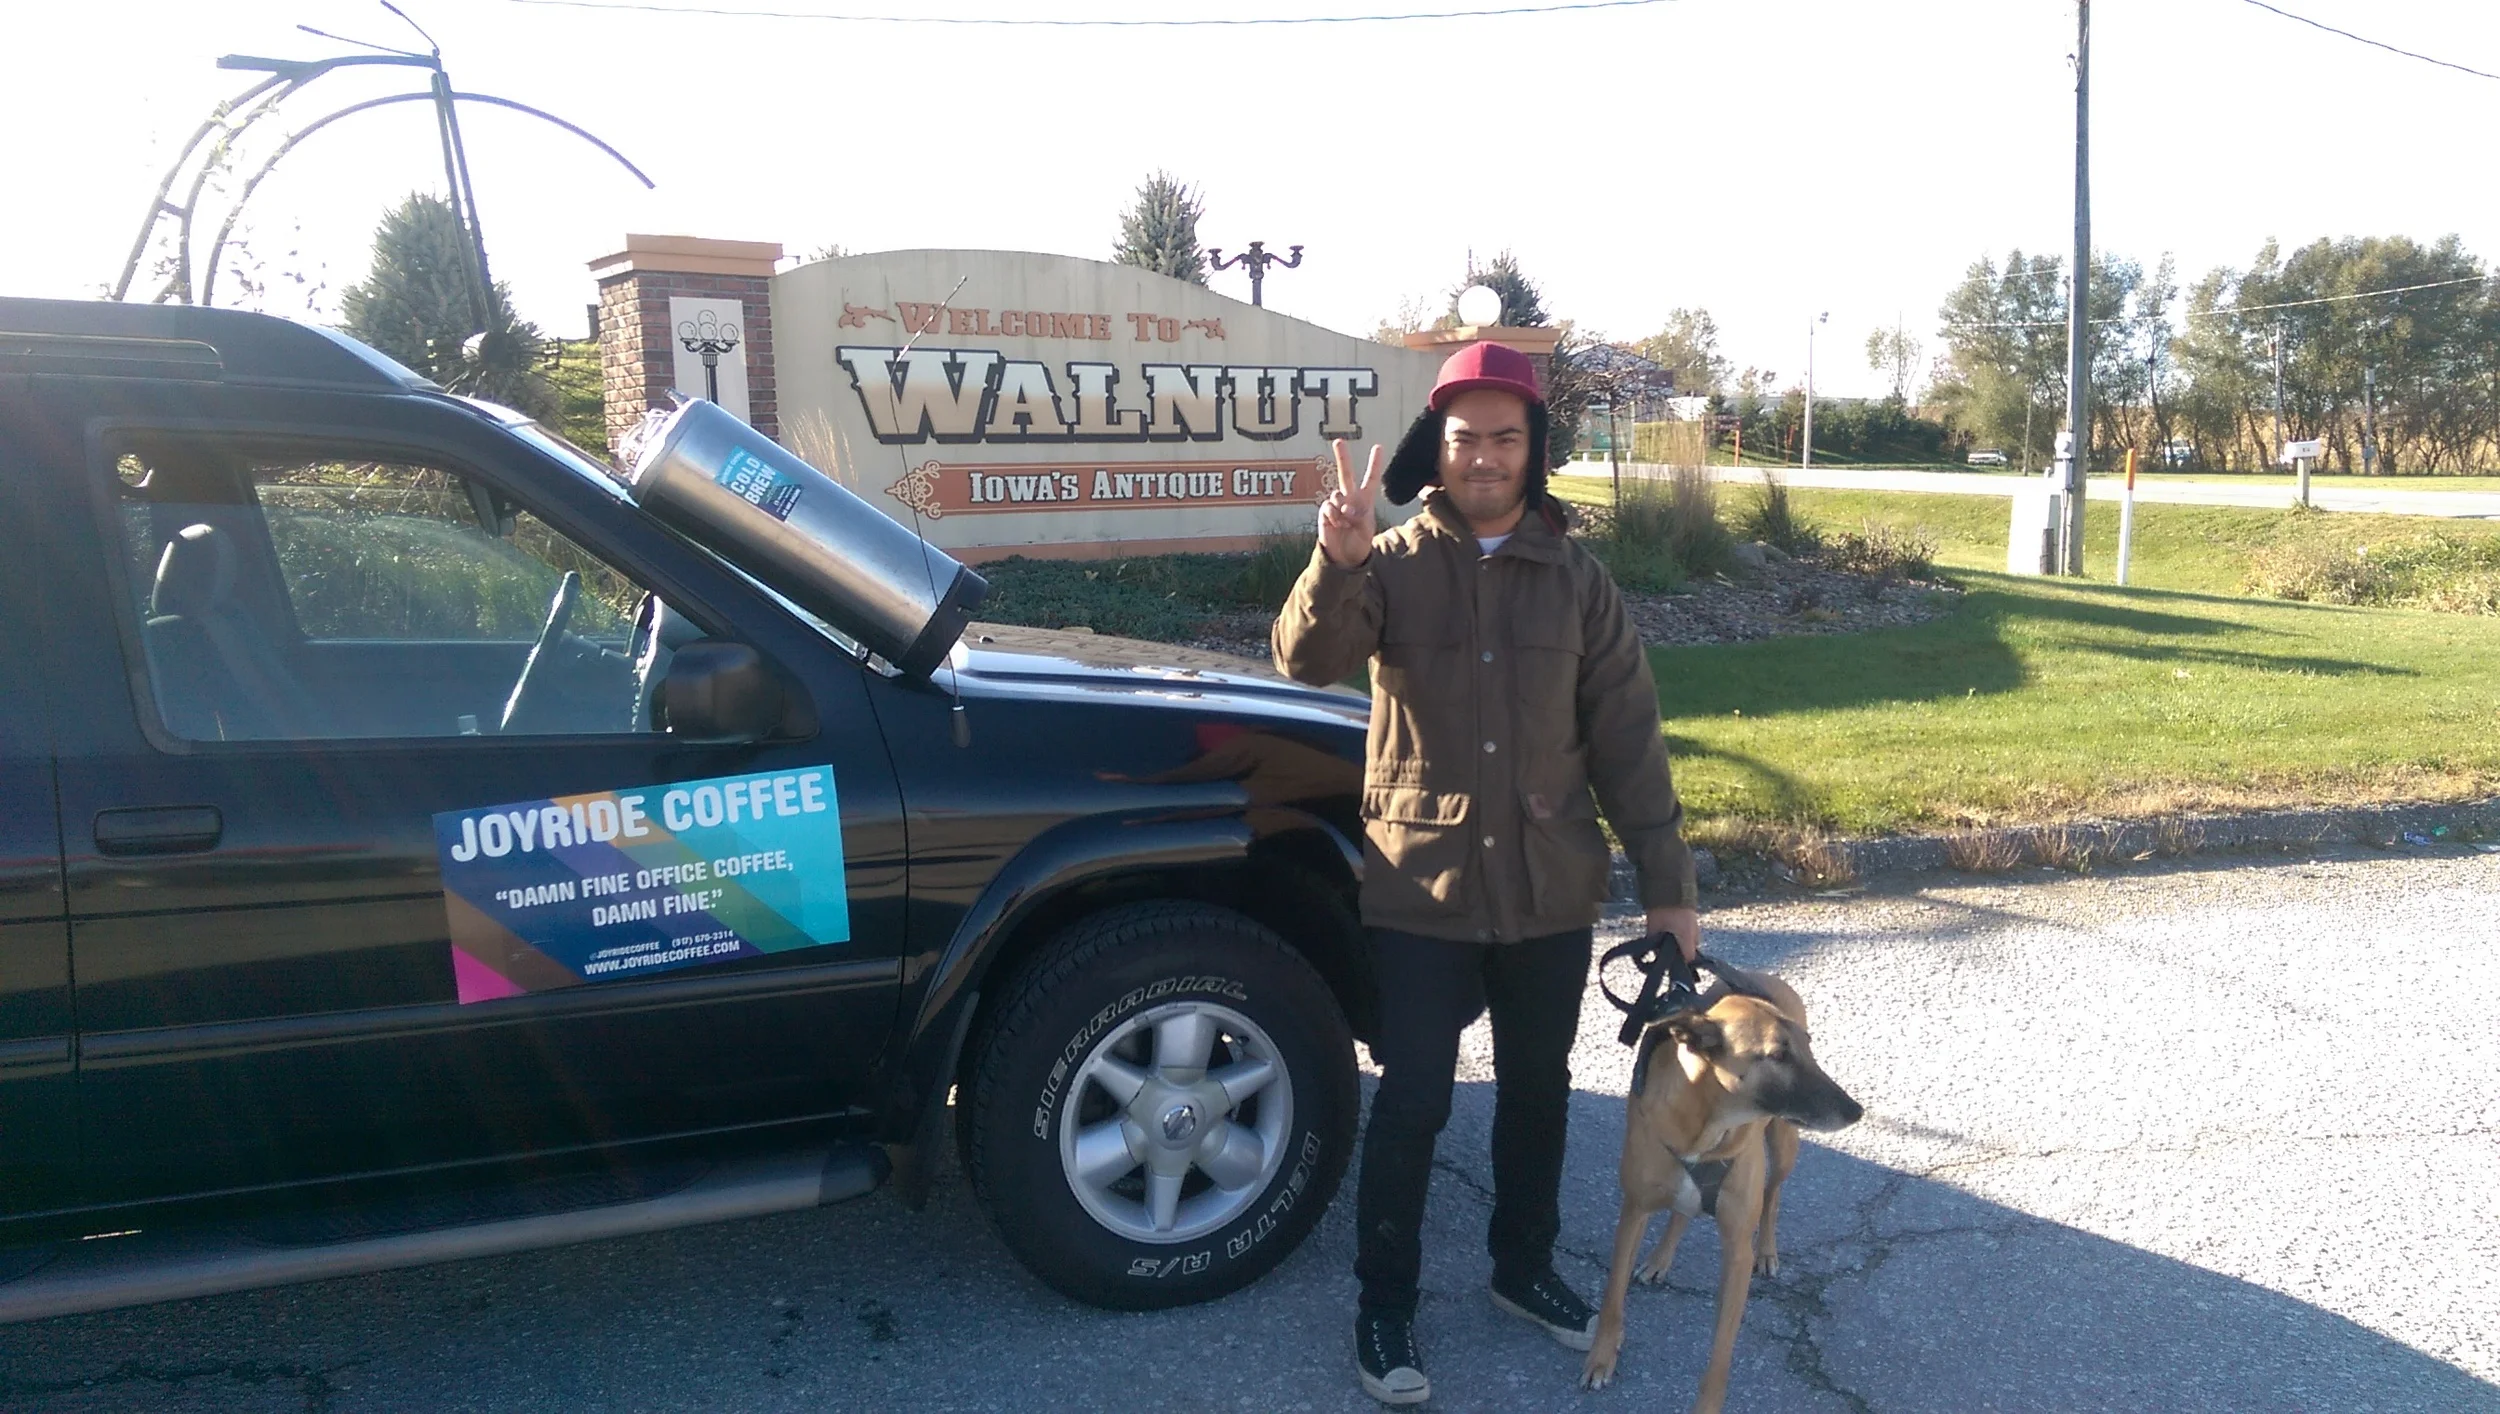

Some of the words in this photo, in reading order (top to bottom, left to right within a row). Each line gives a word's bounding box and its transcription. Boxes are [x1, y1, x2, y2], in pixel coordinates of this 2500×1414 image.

[895, 302, 1112, 341] WELCOME
[1127, 312, 1181, 342] TO
[836, 345, 1378, 443] WALNUT
[730, 457, 760, 493] COLD
[744, 464, 776, 505] BREW
[968, 470, 1081, 504] IOWA'S
[1091, 469, 1226, 502] ANTIQUE
[1232, 468, 1297, 499] CITY
[451, 795, 649, 863] JOYRIDE
[662, 772, 827, 832] COFFEE
[581, 872, 630, 900] FINE
[636, 862, 707, 891] OFFICE
[713, 849, 795, 879] COFFEE,
[592, 899, 657, 928] DAMN
[584, 940, 740, 975] WWW.JOYRIDECOFFEE.COM
[1033, 976, 1248, 1140] SIERRADIAL
[1227, 1131, 1321, 1259] DELTA
[1127, 1250, 1212, 1279] R/S
